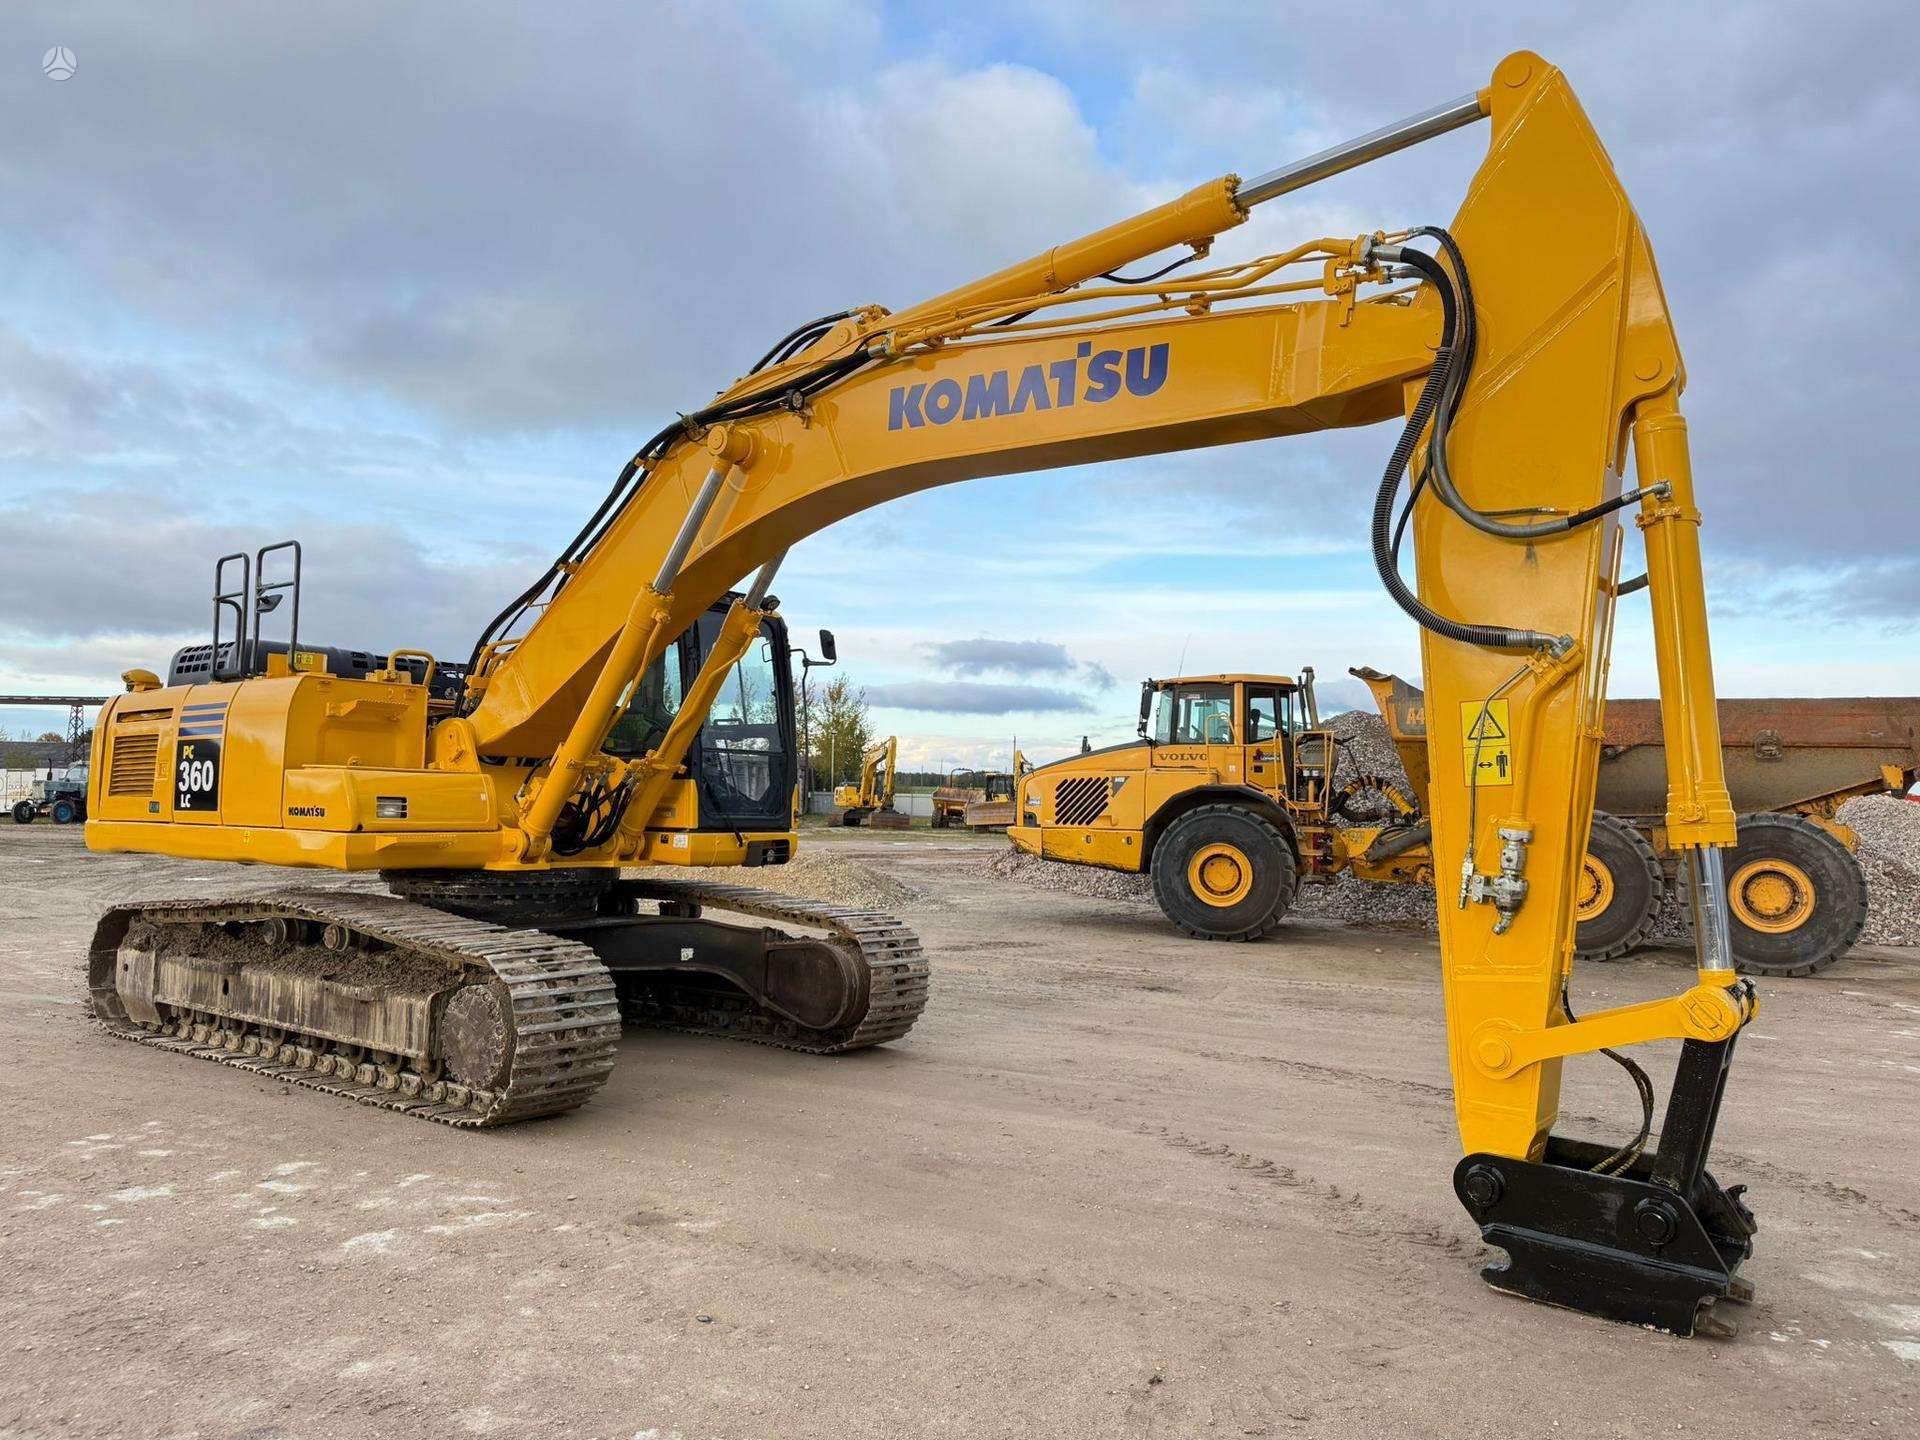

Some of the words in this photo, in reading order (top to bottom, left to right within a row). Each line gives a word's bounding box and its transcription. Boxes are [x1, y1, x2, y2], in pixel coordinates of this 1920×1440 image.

[888, 341, 1169, 430] KOMATSU
[183, 745, 194, 759] PC
[1159, 753, 1208, 761] VOLVO
[179, 760, 214, 791] 360
[181, 794, 191, 808] LC
[288, 805, 325, 817] KOMATSU
